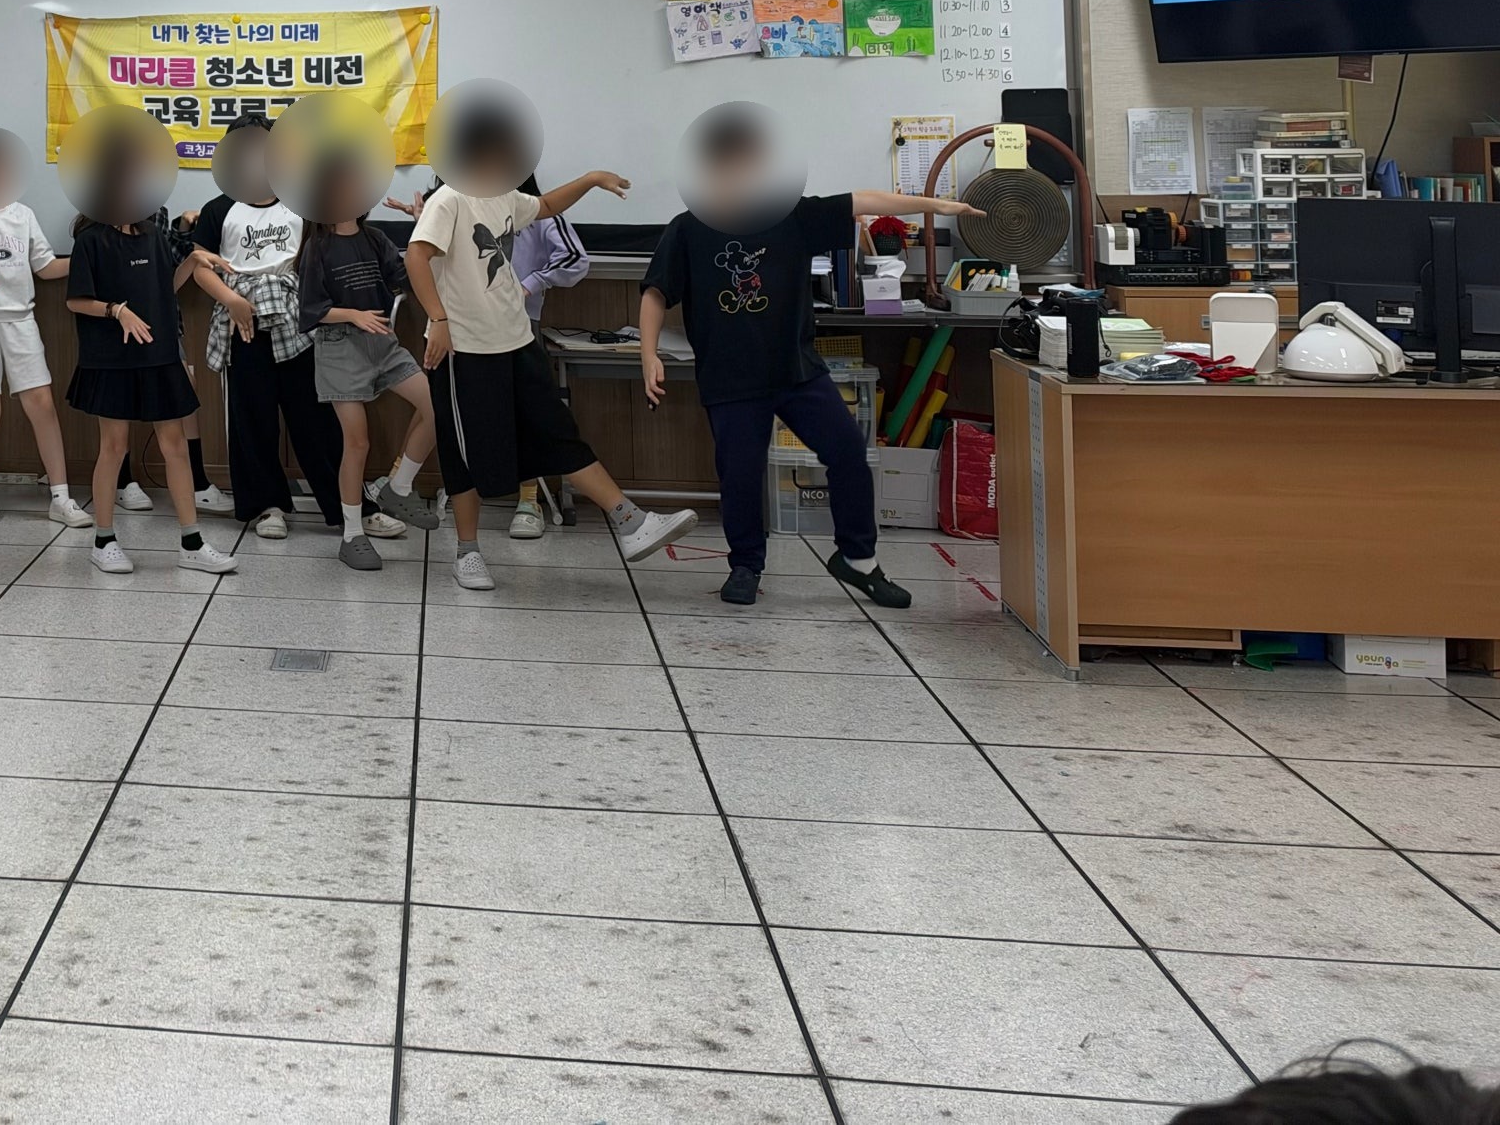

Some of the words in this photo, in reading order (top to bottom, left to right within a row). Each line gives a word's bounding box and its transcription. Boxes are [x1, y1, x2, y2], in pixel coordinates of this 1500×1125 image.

[681, 2, 722, 17] 영어책
[152, 24, 189, 43] 내가
[194, 22, 231, 44] 찾는
[237, 23, 274, 42] 나의
[281, 23, 319, 42] 미래
[110, 56, 196, 87] 미라클
[205, 56, 294, 87] 청소년
[304, 55, 364, 85] 비전
[144, 96, 200, 128] 교육
[210, 97, 300, 125] 프로그
[241, 222, 291, 248] Sandiego
[275, 240, 287, 251] 60
[987, 479, 996, 508] MODA
